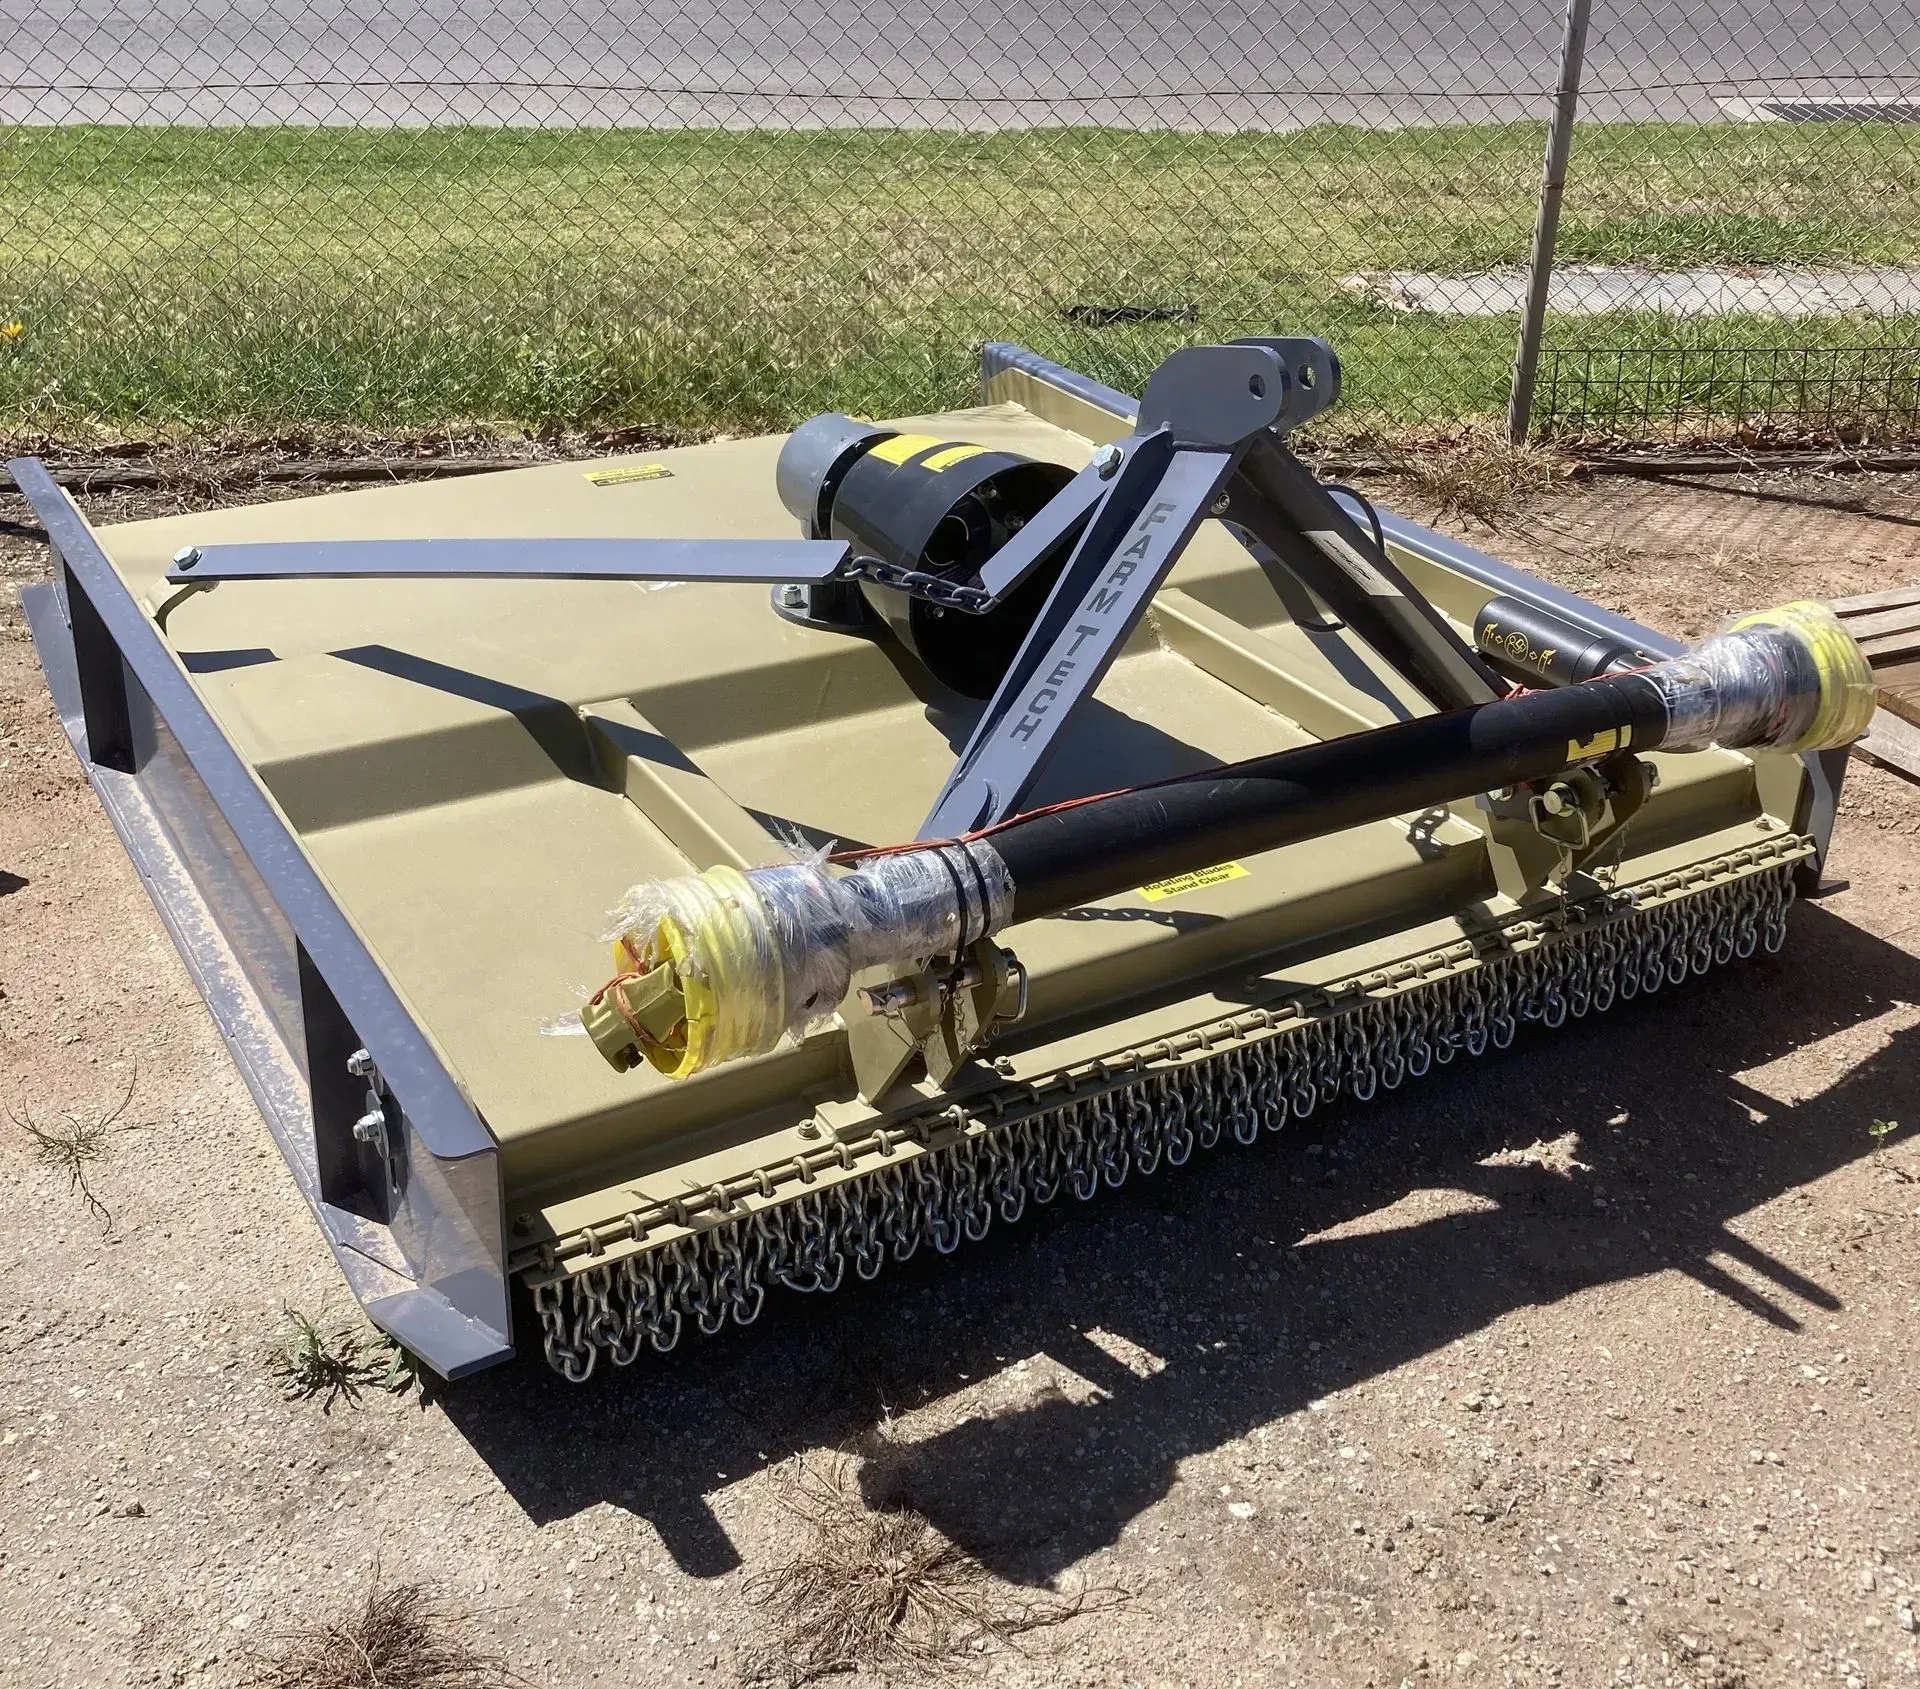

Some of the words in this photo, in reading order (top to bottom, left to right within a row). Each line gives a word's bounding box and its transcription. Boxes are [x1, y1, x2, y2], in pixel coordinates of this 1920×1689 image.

[1086, 502, 1177, 615] FARM
[1010, 624, 1100, 742] TECH
[1142, 874, 1194, 892] Rotating
[1193, 863, 1234, 878] Blades
[1163, 881, 1199, 895] Stand
[1199, 872, 1230, 885] Clear
